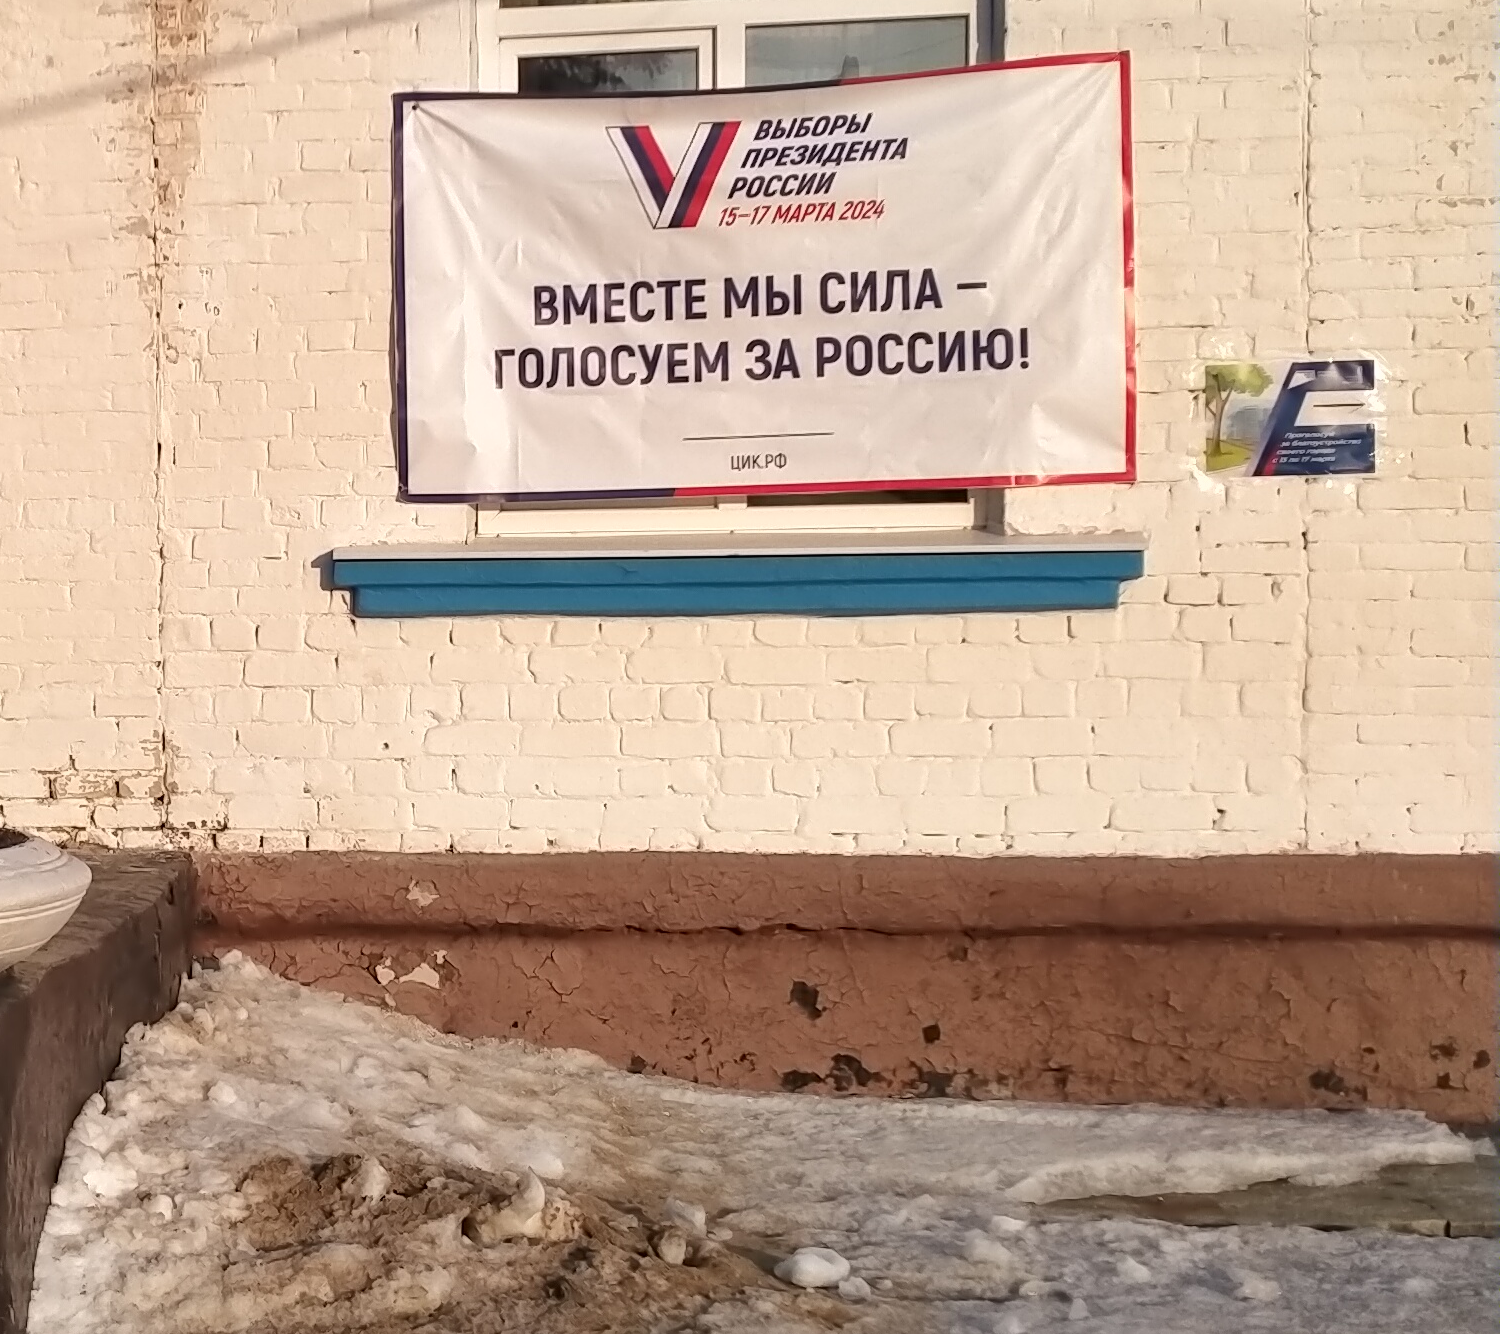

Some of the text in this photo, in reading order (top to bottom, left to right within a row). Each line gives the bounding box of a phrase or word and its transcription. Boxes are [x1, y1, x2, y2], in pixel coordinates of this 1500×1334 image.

[753, 112, 873, 142] ВЫБОРЫ
[740, 137, 909, 169] ПРЕЗИДЕНТА
[727, 171, 837, 199] РОССИИ
[773, 202, 838, 225] МАРТА
[837, 199, 886, 221] 2024
[533, 278, 708, 326] ВМЕСТЕ
[724, 274, 802, 319] МЫ
[819, 268, 943, 314] СИЛА
[494, 327, 1030, 390] ГОЛОСУЕМ ЗА РОССИЮ!
[730, 453, 788, 472] ЦИК.РФ
